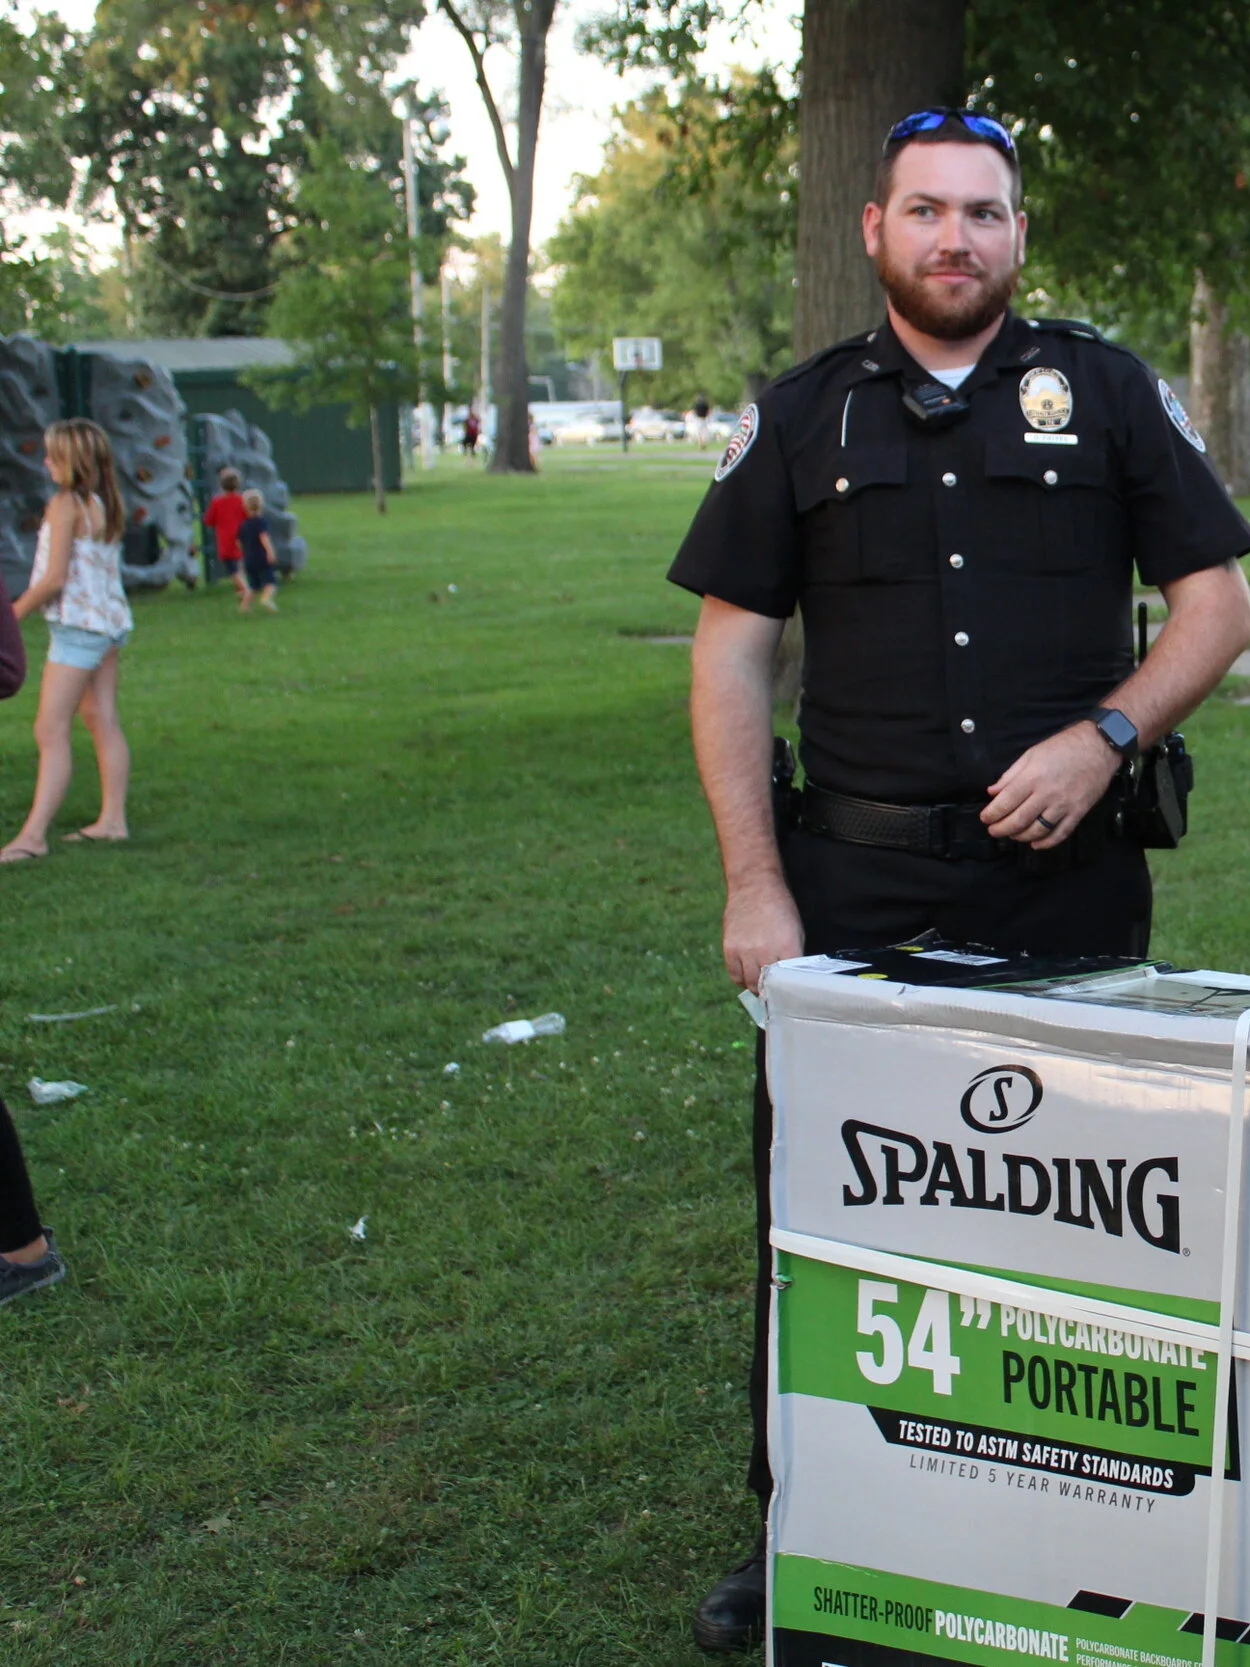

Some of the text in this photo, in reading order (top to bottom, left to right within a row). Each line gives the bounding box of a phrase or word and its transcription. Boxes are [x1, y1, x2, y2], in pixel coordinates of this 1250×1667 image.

[840, 1119, 1181, 1255] SPALDING
[1001, 1303, 1207, 1370] POLYCARBONATE
[1002, 1349, 1200, 1437] PORTABLE
[899, 1419, 1174, 1489] TESTED TO ASTM SAFETY STANDARDS
[909, 1453, 1156, 1514] LIMITED 5 YEAR WARRANTY
[813, 1586, 1069, 1663] SHATTER-PROOF POLYCARBONATE
[1076, 1637, 1192, 1667] POLYCARBONATE BACKBOARDS
[1076, 1654, 1130, 1667] PERFORMAN
